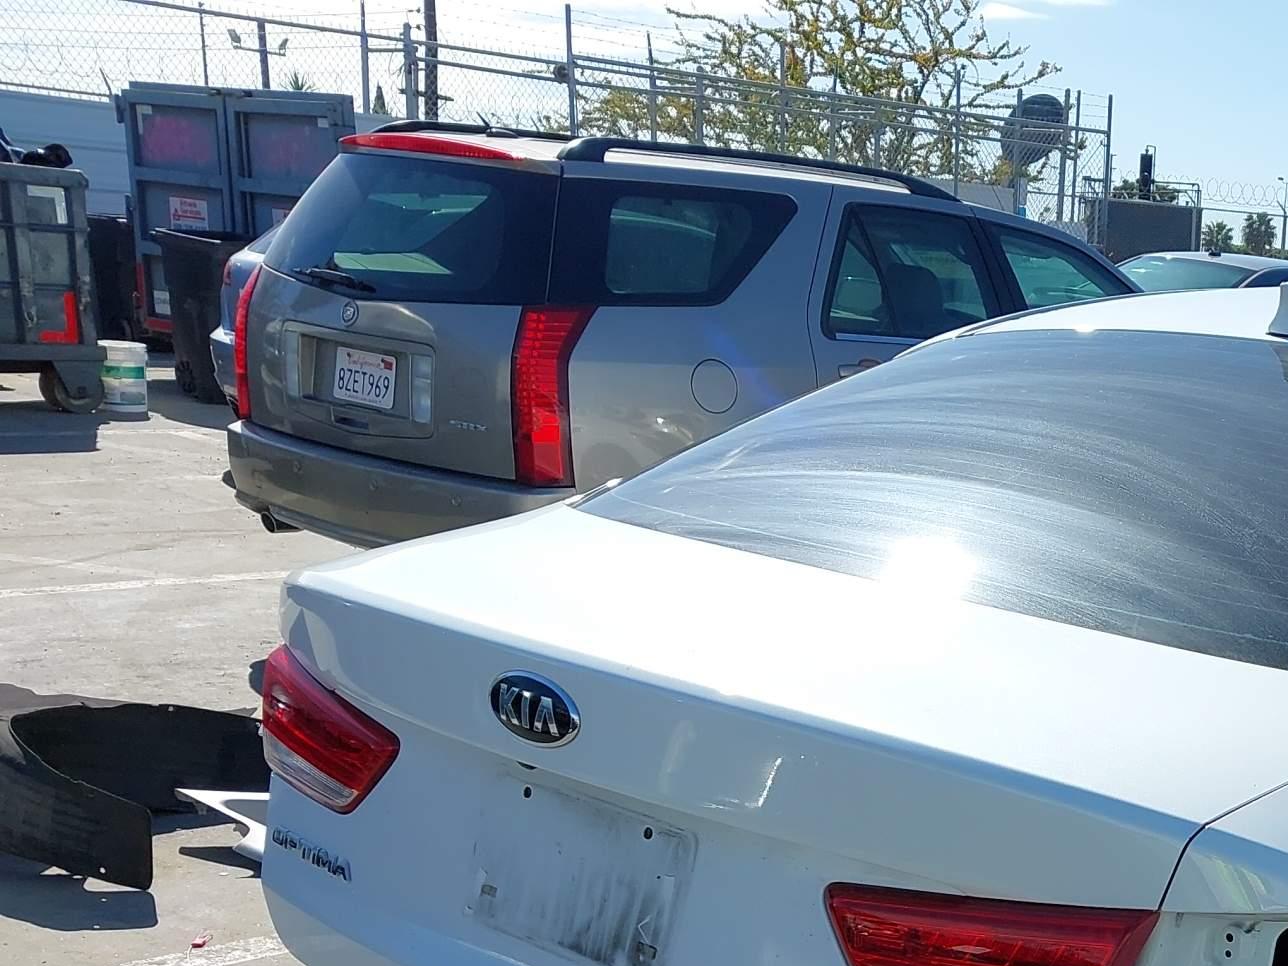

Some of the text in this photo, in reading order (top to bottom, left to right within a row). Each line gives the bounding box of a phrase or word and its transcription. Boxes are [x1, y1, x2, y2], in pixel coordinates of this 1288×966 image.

[337, 367, 390, 399] 8ZET969
[499, 682, 560, 737] KIA
[272, 825, 352, 882] OPTIMA
